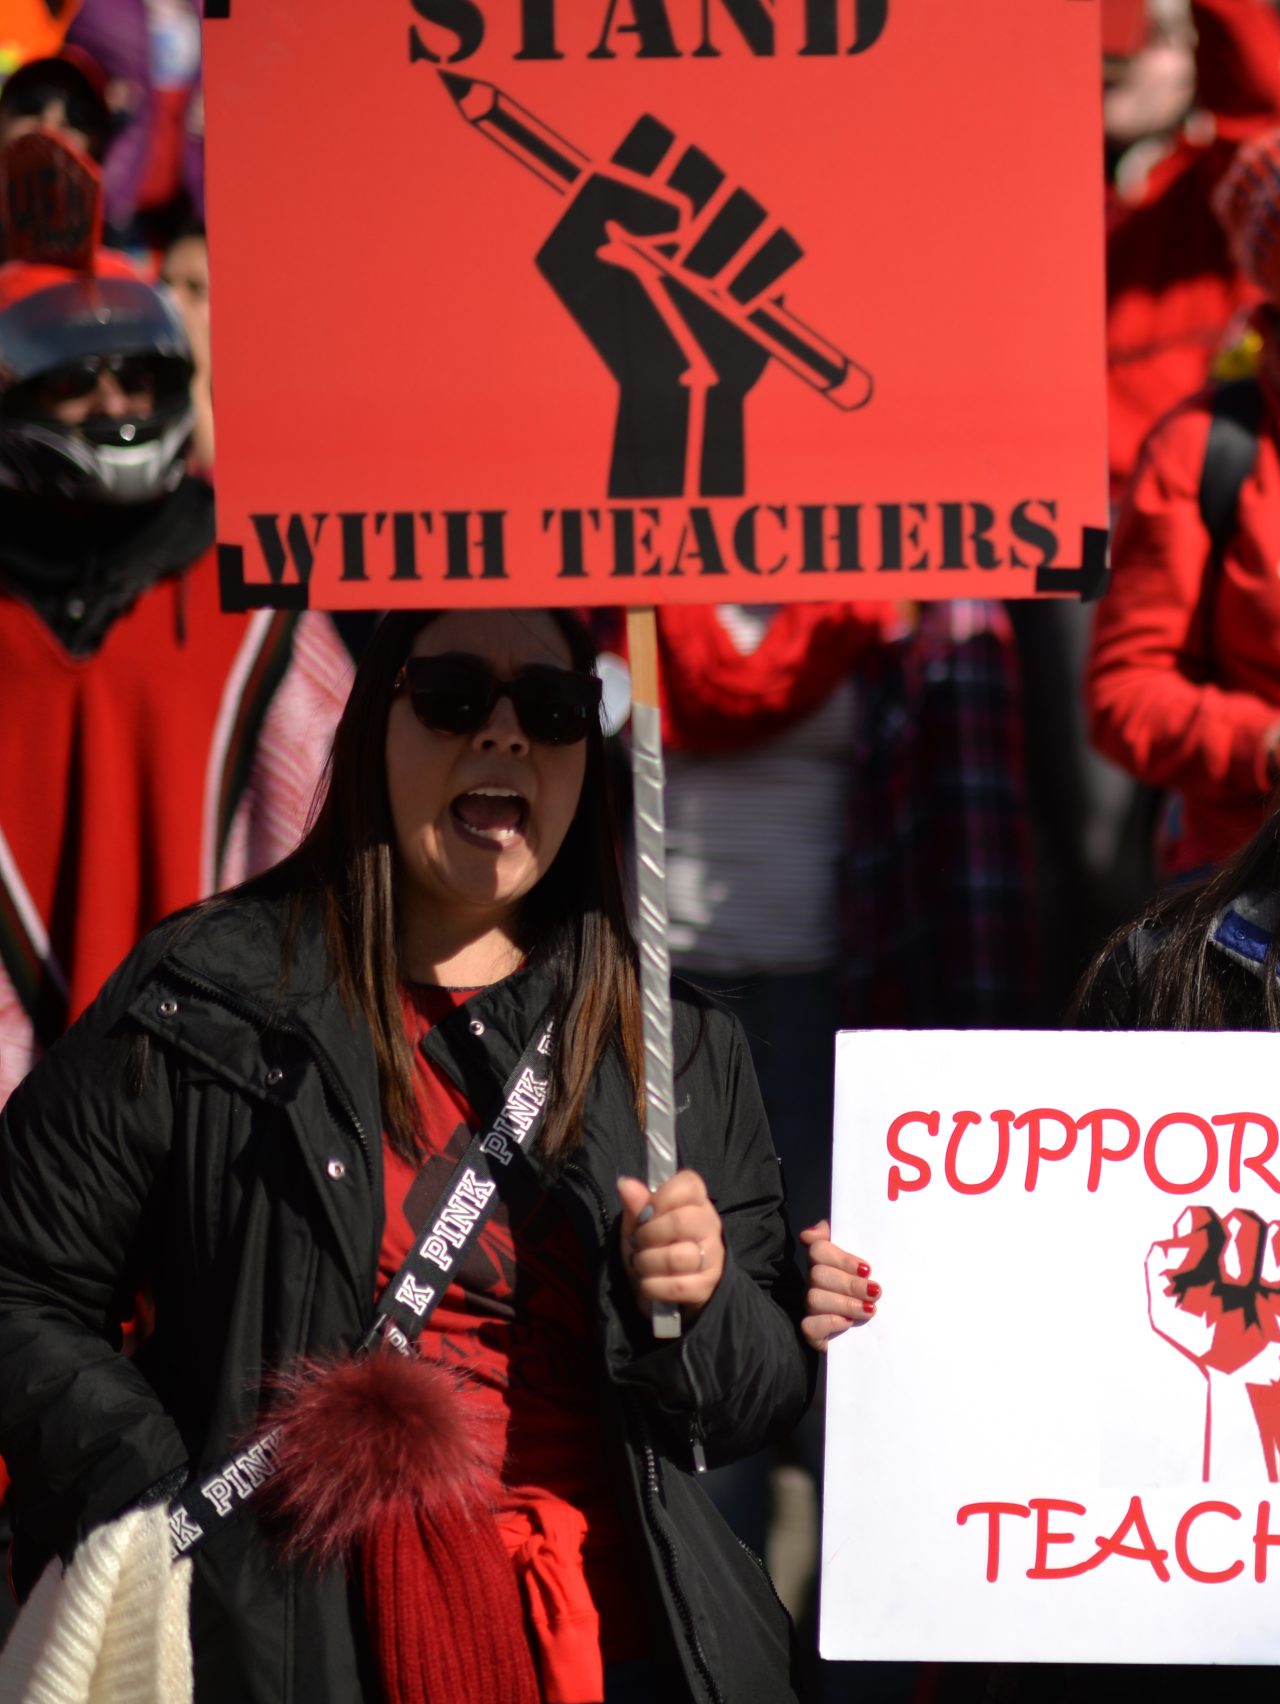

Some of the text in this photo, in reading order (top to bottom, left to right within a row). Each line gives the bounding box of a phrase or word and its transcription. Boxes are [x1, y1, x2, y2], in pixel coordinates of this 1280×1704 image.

[408, 0, 890, 65] STAND
[248, 499, 1059, 584] WITH TEACHERS
[480, 1066, 548, 1167] PINK
[420, 1166, 497, 1273] PINK
[200, 1426, 282, 1517] PIN
